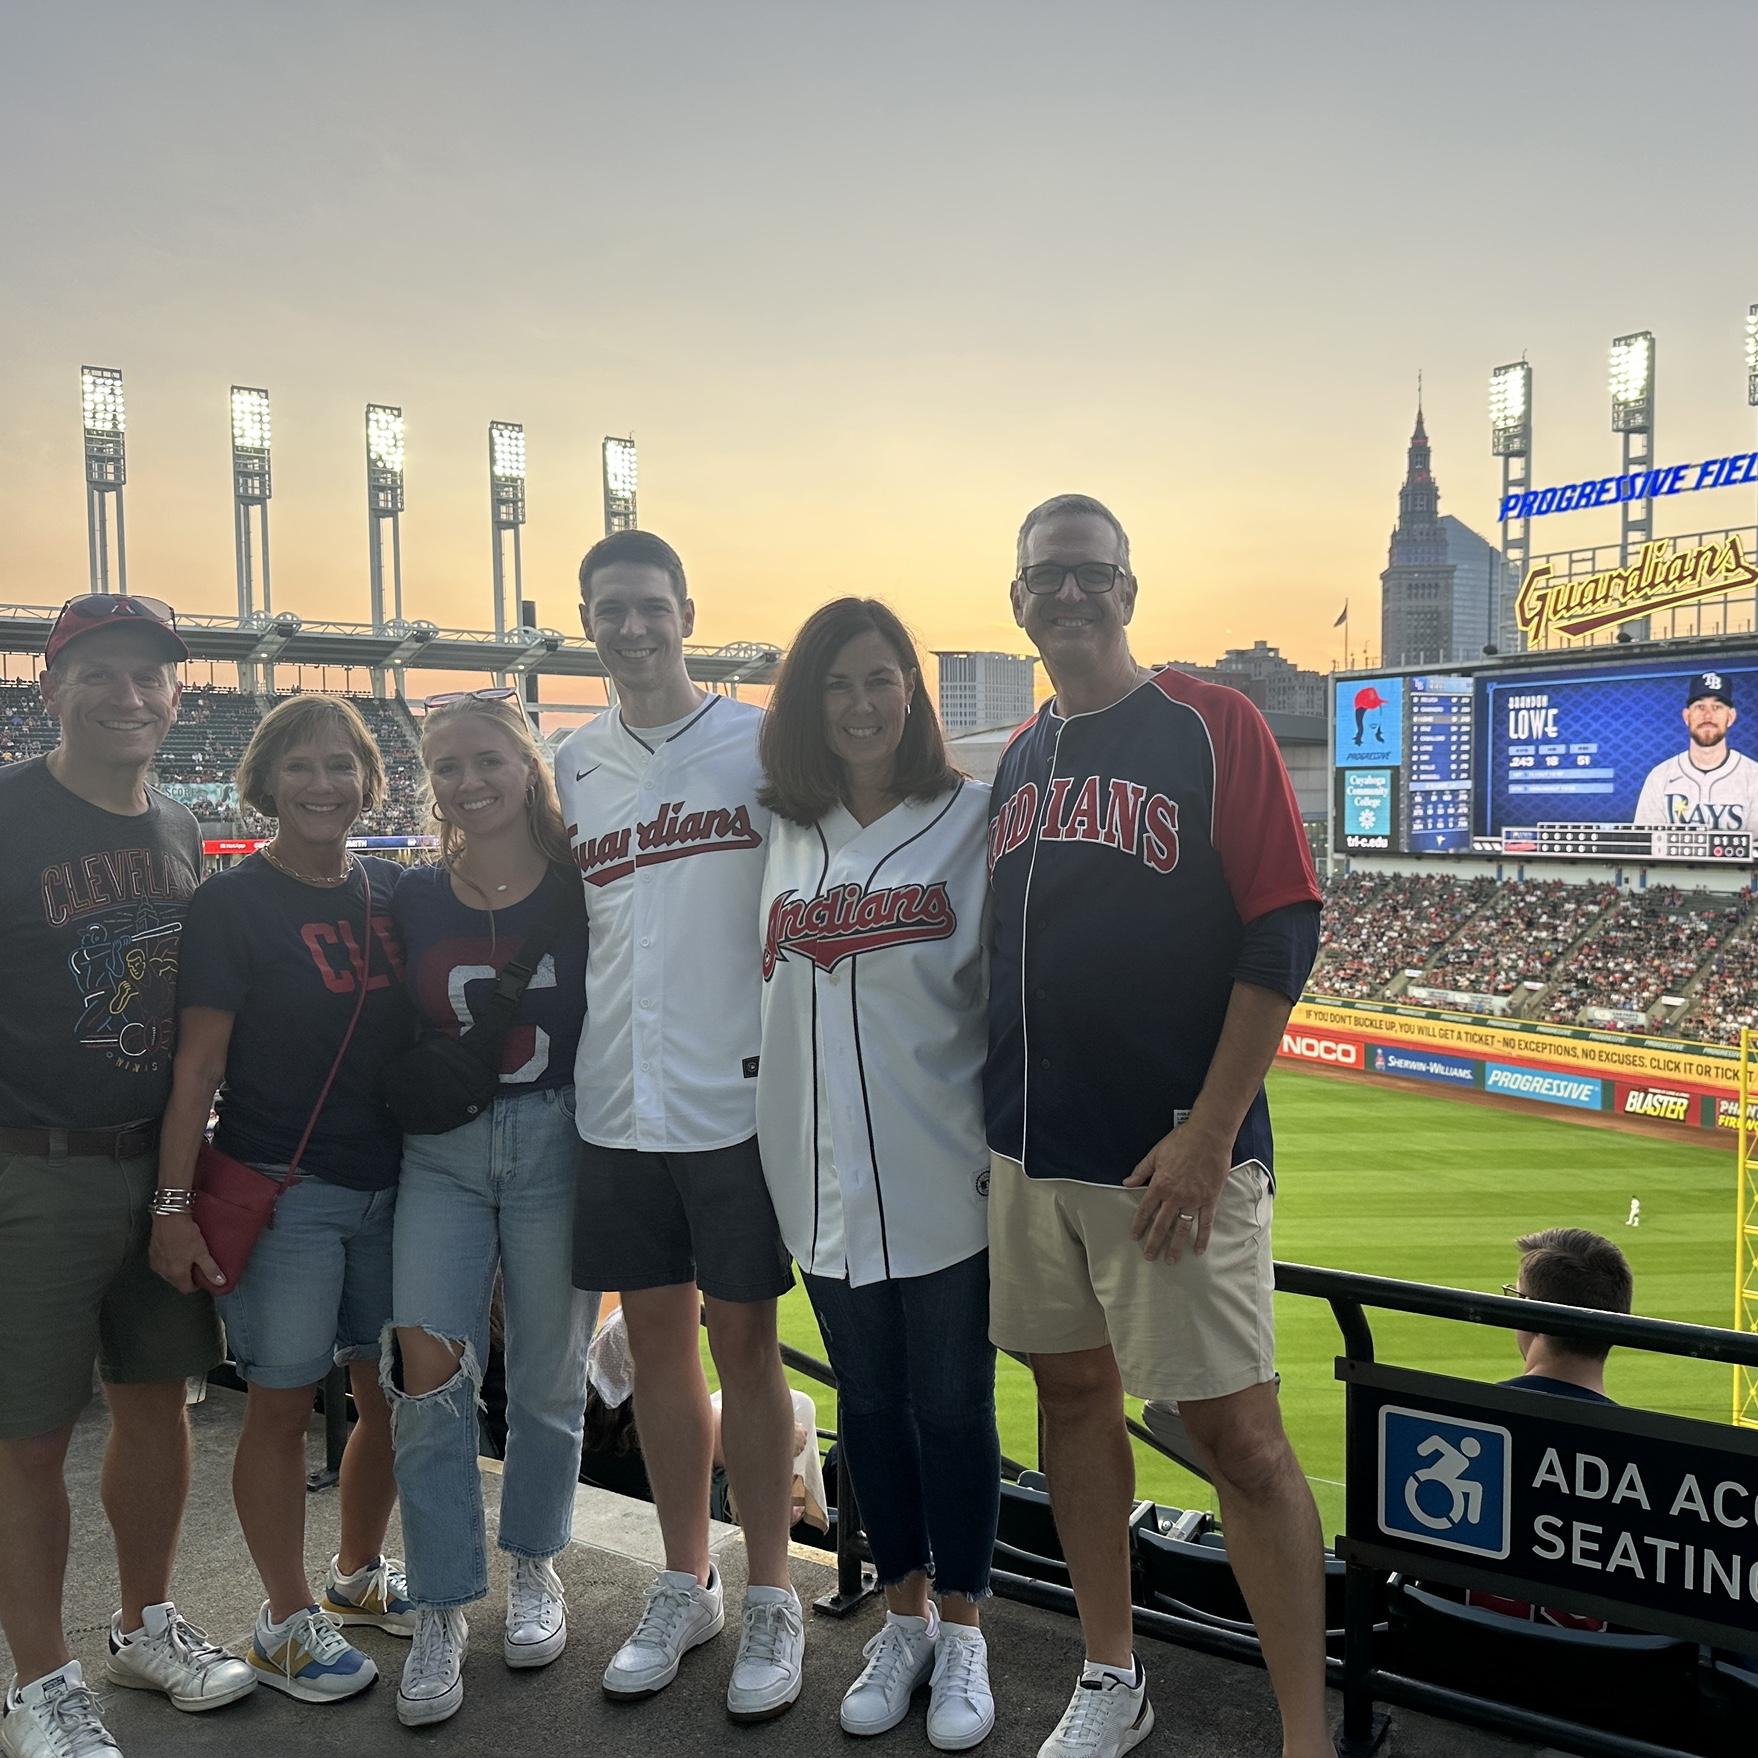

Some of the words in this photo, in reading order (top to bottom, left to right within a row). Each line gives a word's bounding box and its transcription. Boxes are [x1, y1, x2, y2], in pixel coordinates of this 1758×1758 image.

[1497, 464, 1692, 522] PROGRESSIVE
[1515, 534, 1756, 648] Guardians
[1508, 708, 1559, 740] LOWE
[1664, 793, 1744, 831] RAYS
[568, 801, 761, 885] uardians
[1347, 836, 1388, 849] tri-c.edu
[762, 881, 957, 980] Indians
[1282, 1034, 1356, 1064] NOCO
[1305, 1010, 1313, 1020] IF
[1313, 1012, 1329, 1022] YOU
[1330, 1013, 1352, 1025] DON'T
[1354, 1016, 1384, 1030] BUCKLE
[1399, 1022, 1415, 1035] YOU
[1417, 1025, 1436, 1038] WILL
[1438, 1028, 1455, 1040] GET
[1456, 1030, 1463, 1041] A
[1464, 1031, 1496, 1046] TICKET
[1502, 1037, 1515, 1049] NO
[1518, 1039, 1579, 1059] EXCEPTIONS,
[1581, 1048, 1596, 1060] NO
[1597, 1050, 1647, 1069] EXCUSES.
[1649, 1057, 1681, 1073] CLICK
[1684, 1062, 1694, 1075] IT
[1696, 1064, 1712, 1078] OR
[1713, 1066, 1754, 1083] TICKT
[1488, 1069, 1596, 1101] PROGRESSIVE
[1625, 1090, 1689, 1120] BLASTER
[1532, 1447, 1651, 1511] ADA
[1669, 1473, 1758, 1529] AC
[1532, 1515, 1758, 1604] SEATIN
